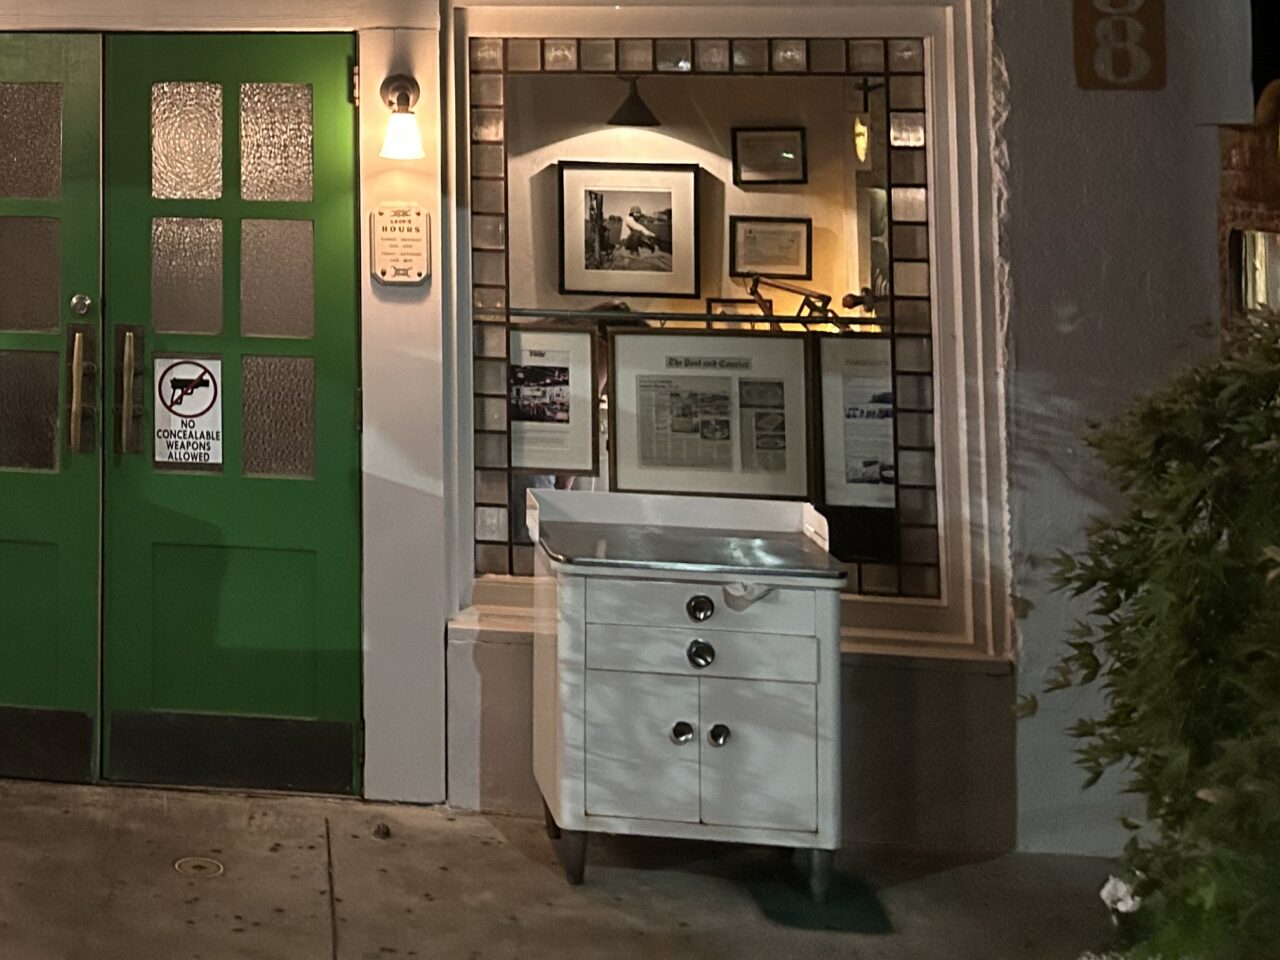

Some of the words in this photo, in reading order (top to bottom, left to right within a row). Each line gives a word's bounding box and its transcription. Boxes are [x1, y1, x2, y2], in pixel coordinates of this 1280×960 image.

[381, 225, 420, 234] HOURS
[180, 419, 196, 430] NO
[156, 429, 221, 441] CONCEALABLE
[166, 440, 211, 452] WEAPONS
[167, 451, 211, 462] ALLOWED
